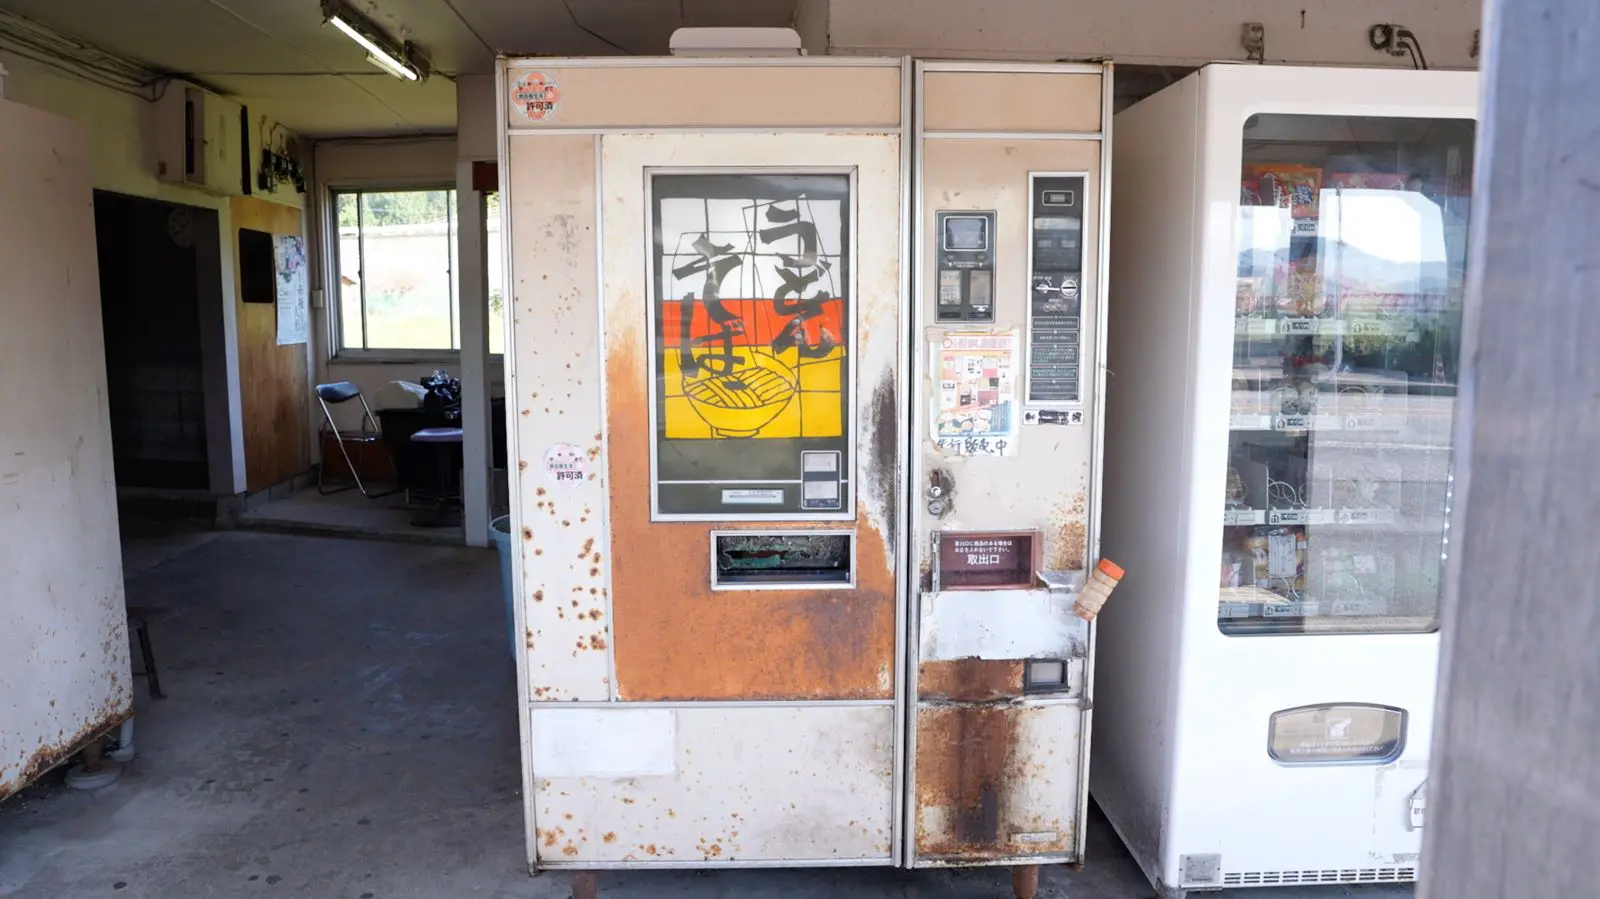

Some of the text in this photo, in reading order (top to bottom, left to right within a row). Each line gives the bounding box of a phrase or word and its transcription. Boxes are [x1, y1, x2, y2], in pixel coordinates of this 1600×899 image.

[759, 203, 836, 358] うどん
[556, 471, 583, 480] 許可済
[967, 554, 1000, 565] 取出口
